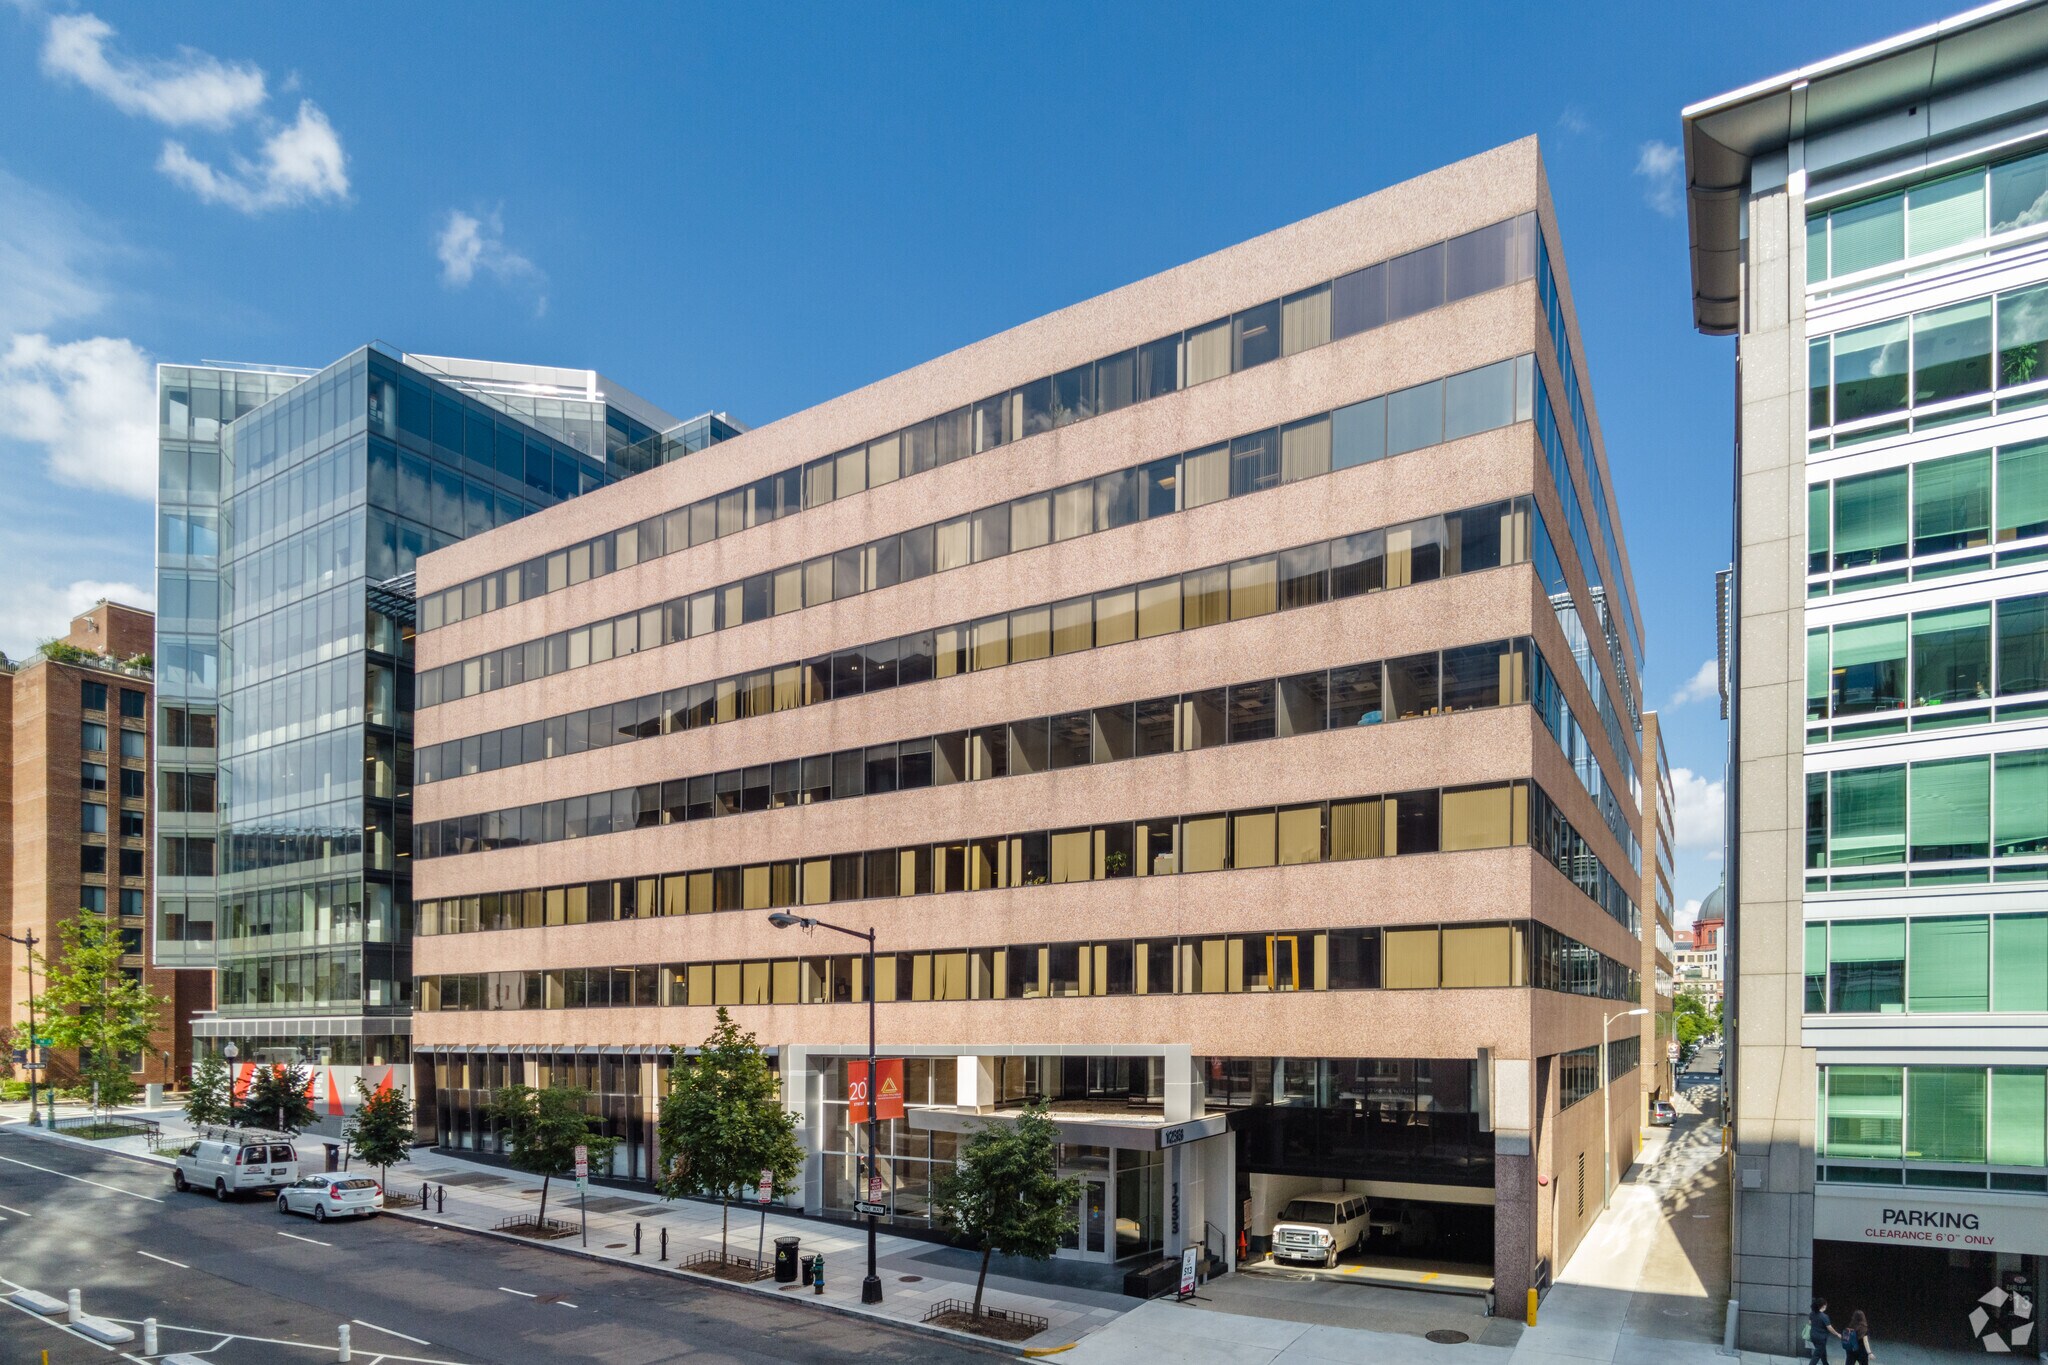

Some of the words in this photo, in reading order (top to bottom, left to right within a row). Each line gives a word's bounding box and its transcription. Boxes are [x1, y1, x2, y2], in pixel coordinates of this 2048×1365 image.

[849, 1081, 867, 1100] 20
[1882, 1208, 1979, 1230] PARKING
[1865, 1228, 1932, 1240] CLEARANCE
[1935, 1233, 1960, 1243] 6'0"
[1964, 1235, 1995, 1245] ONLY
